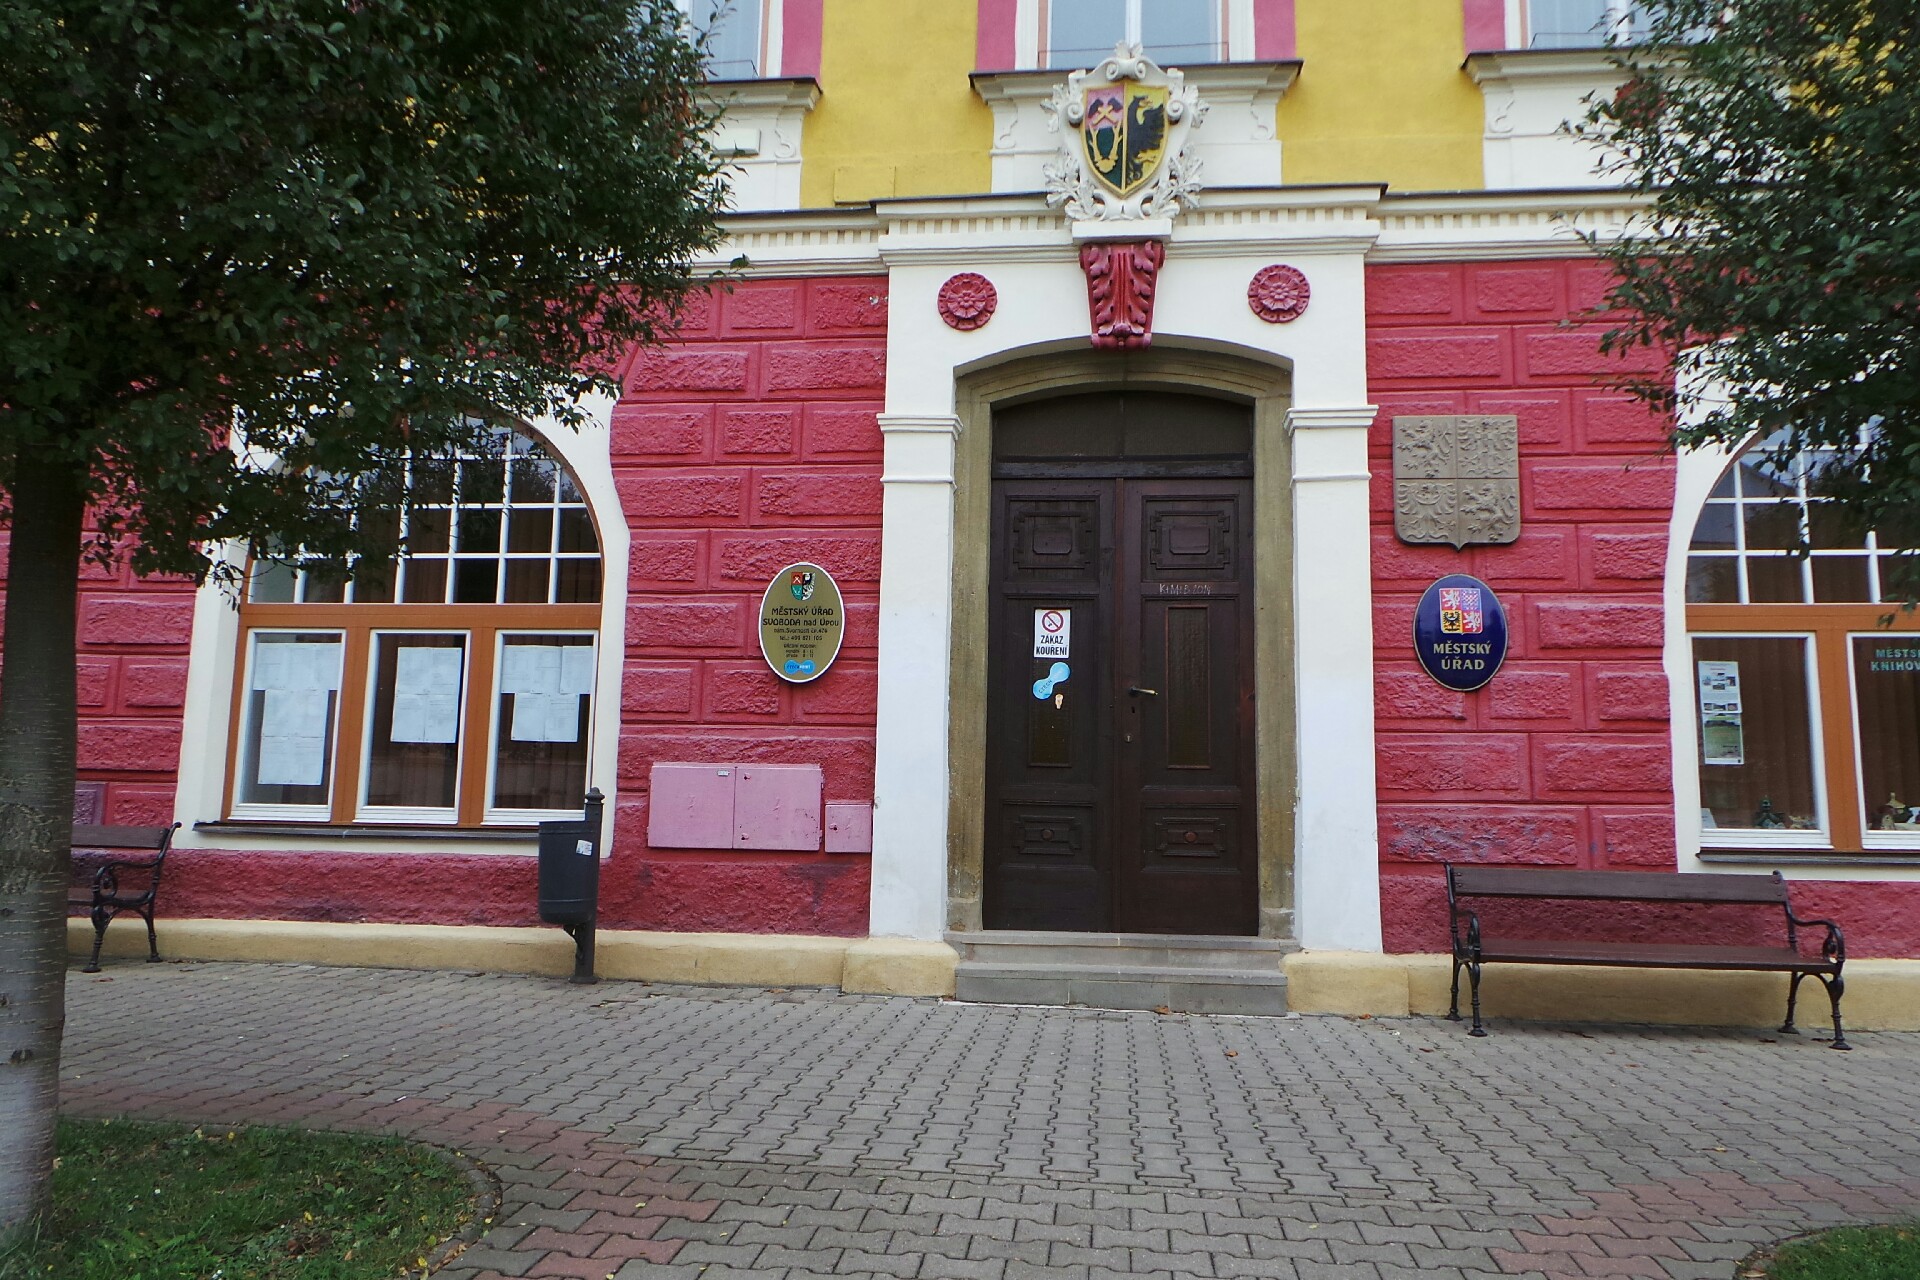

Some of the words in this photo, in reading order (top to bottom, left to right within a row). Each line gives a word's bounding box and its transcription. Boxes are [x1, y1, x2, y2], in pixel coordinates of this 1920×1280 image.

[771, 606, 809, 616] MĚSTSKÝ
[811, 606, 834, 616] ÚŘAD
[762, 618, 800, 626] SVOBODA
[803, 618, 817, 626] nad
[1036, 645, 1068, 656] KOUŘENÍ
[1433, 640, 1492, 654] MĚSTSKÝ
[1441, 656, 1485, 670] ÚŘAD
